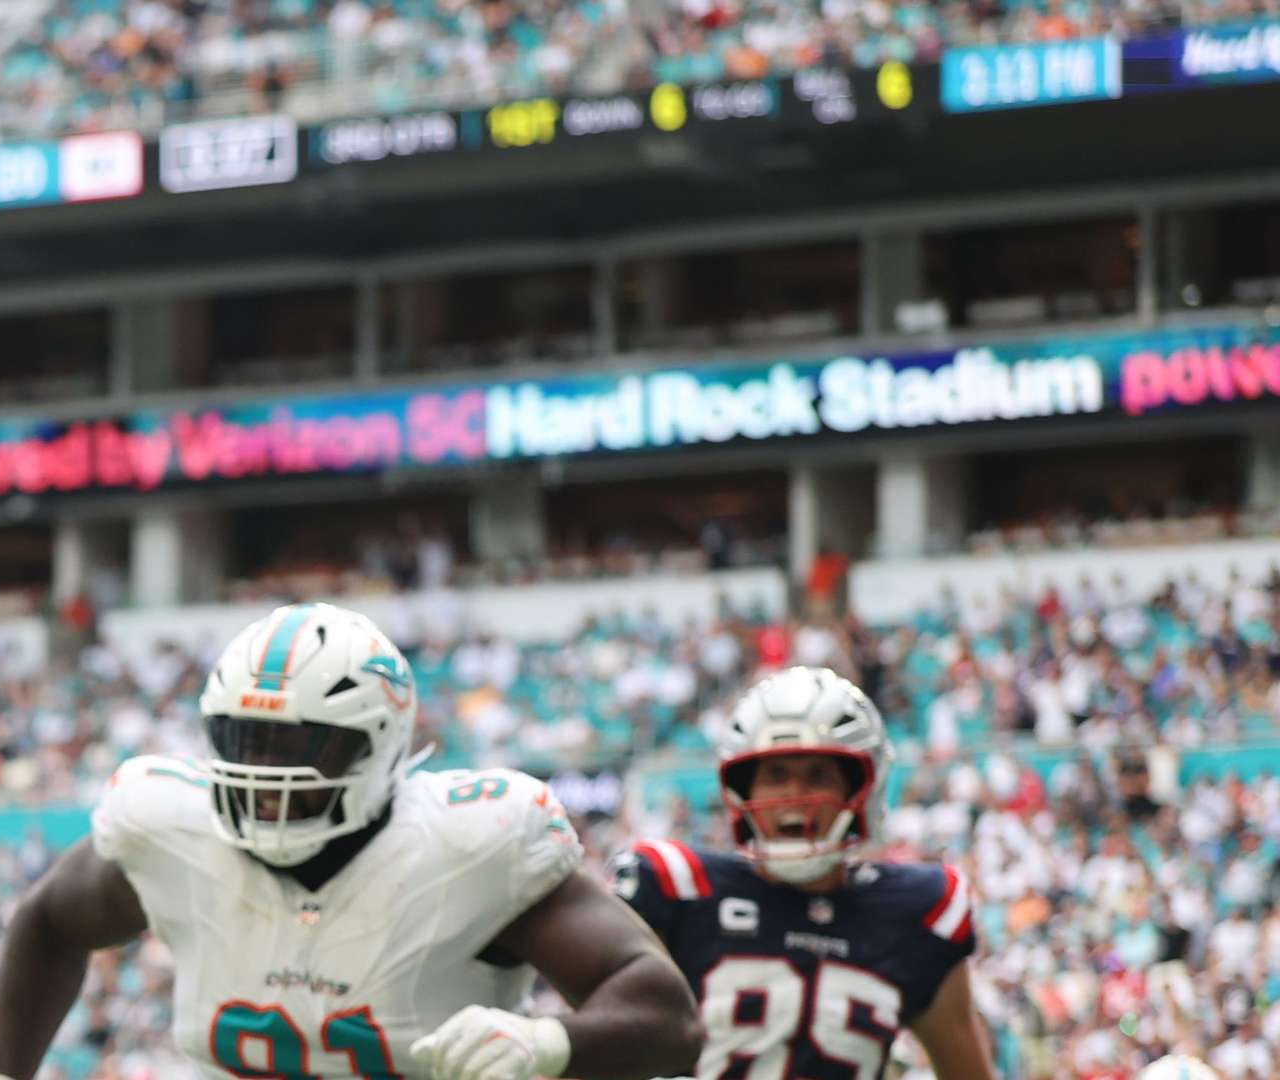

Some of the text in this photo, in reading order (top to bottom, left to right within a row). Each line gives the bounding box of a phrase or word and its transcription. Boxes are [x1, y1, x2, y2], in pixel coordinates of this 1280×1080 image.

[486, 346, 1103, 459] Hard Rock Stadium
